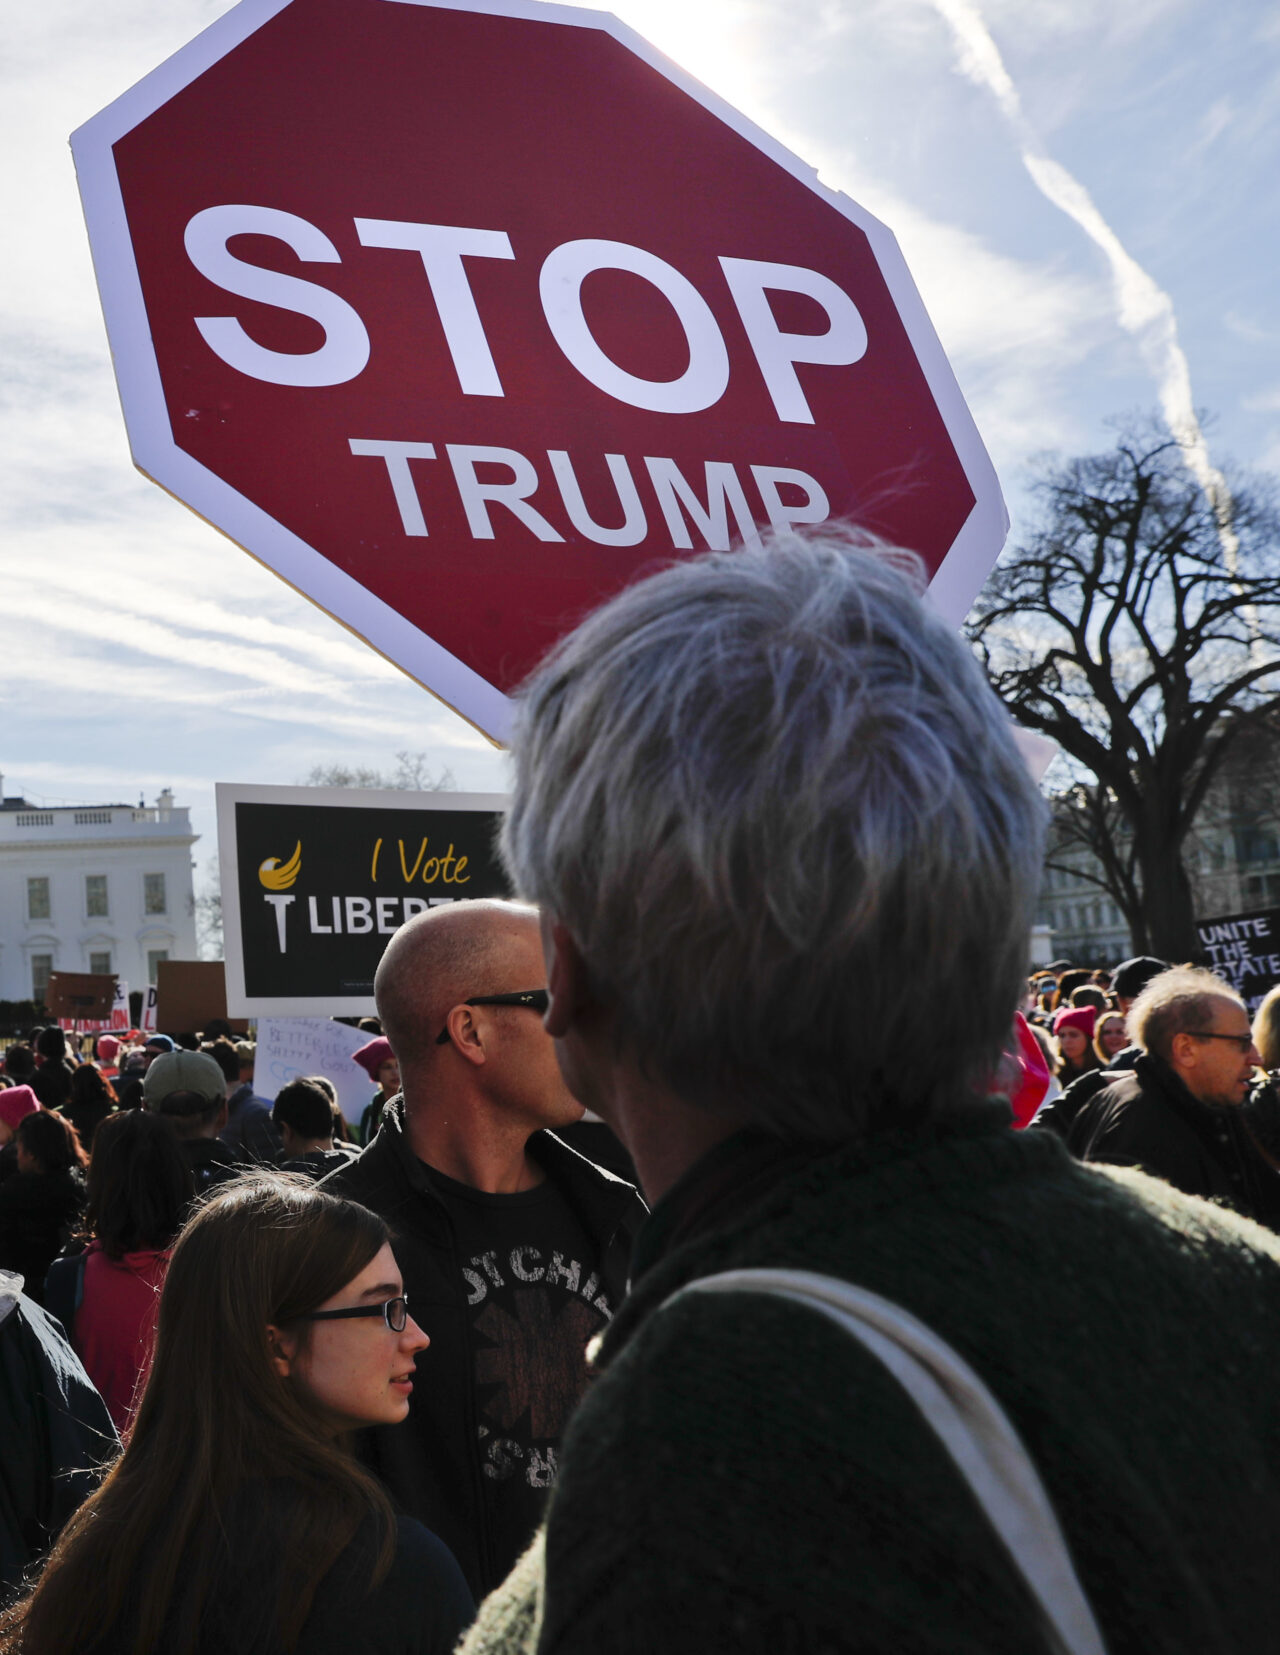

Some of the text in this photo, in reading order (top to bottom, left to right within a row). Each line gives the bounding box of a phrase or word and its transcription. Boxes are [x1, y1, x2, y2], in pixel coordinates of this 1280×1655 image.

[184, 204, 868, 424] STOP
[348, 438, 830, 551] TRUMP
[371, 836, 470, 883] I Vote
[308, 895, 456, 934] LIBER
[1198, 917, 1272, 945] UNITE
[1203, 940, 1252, 964] THE
